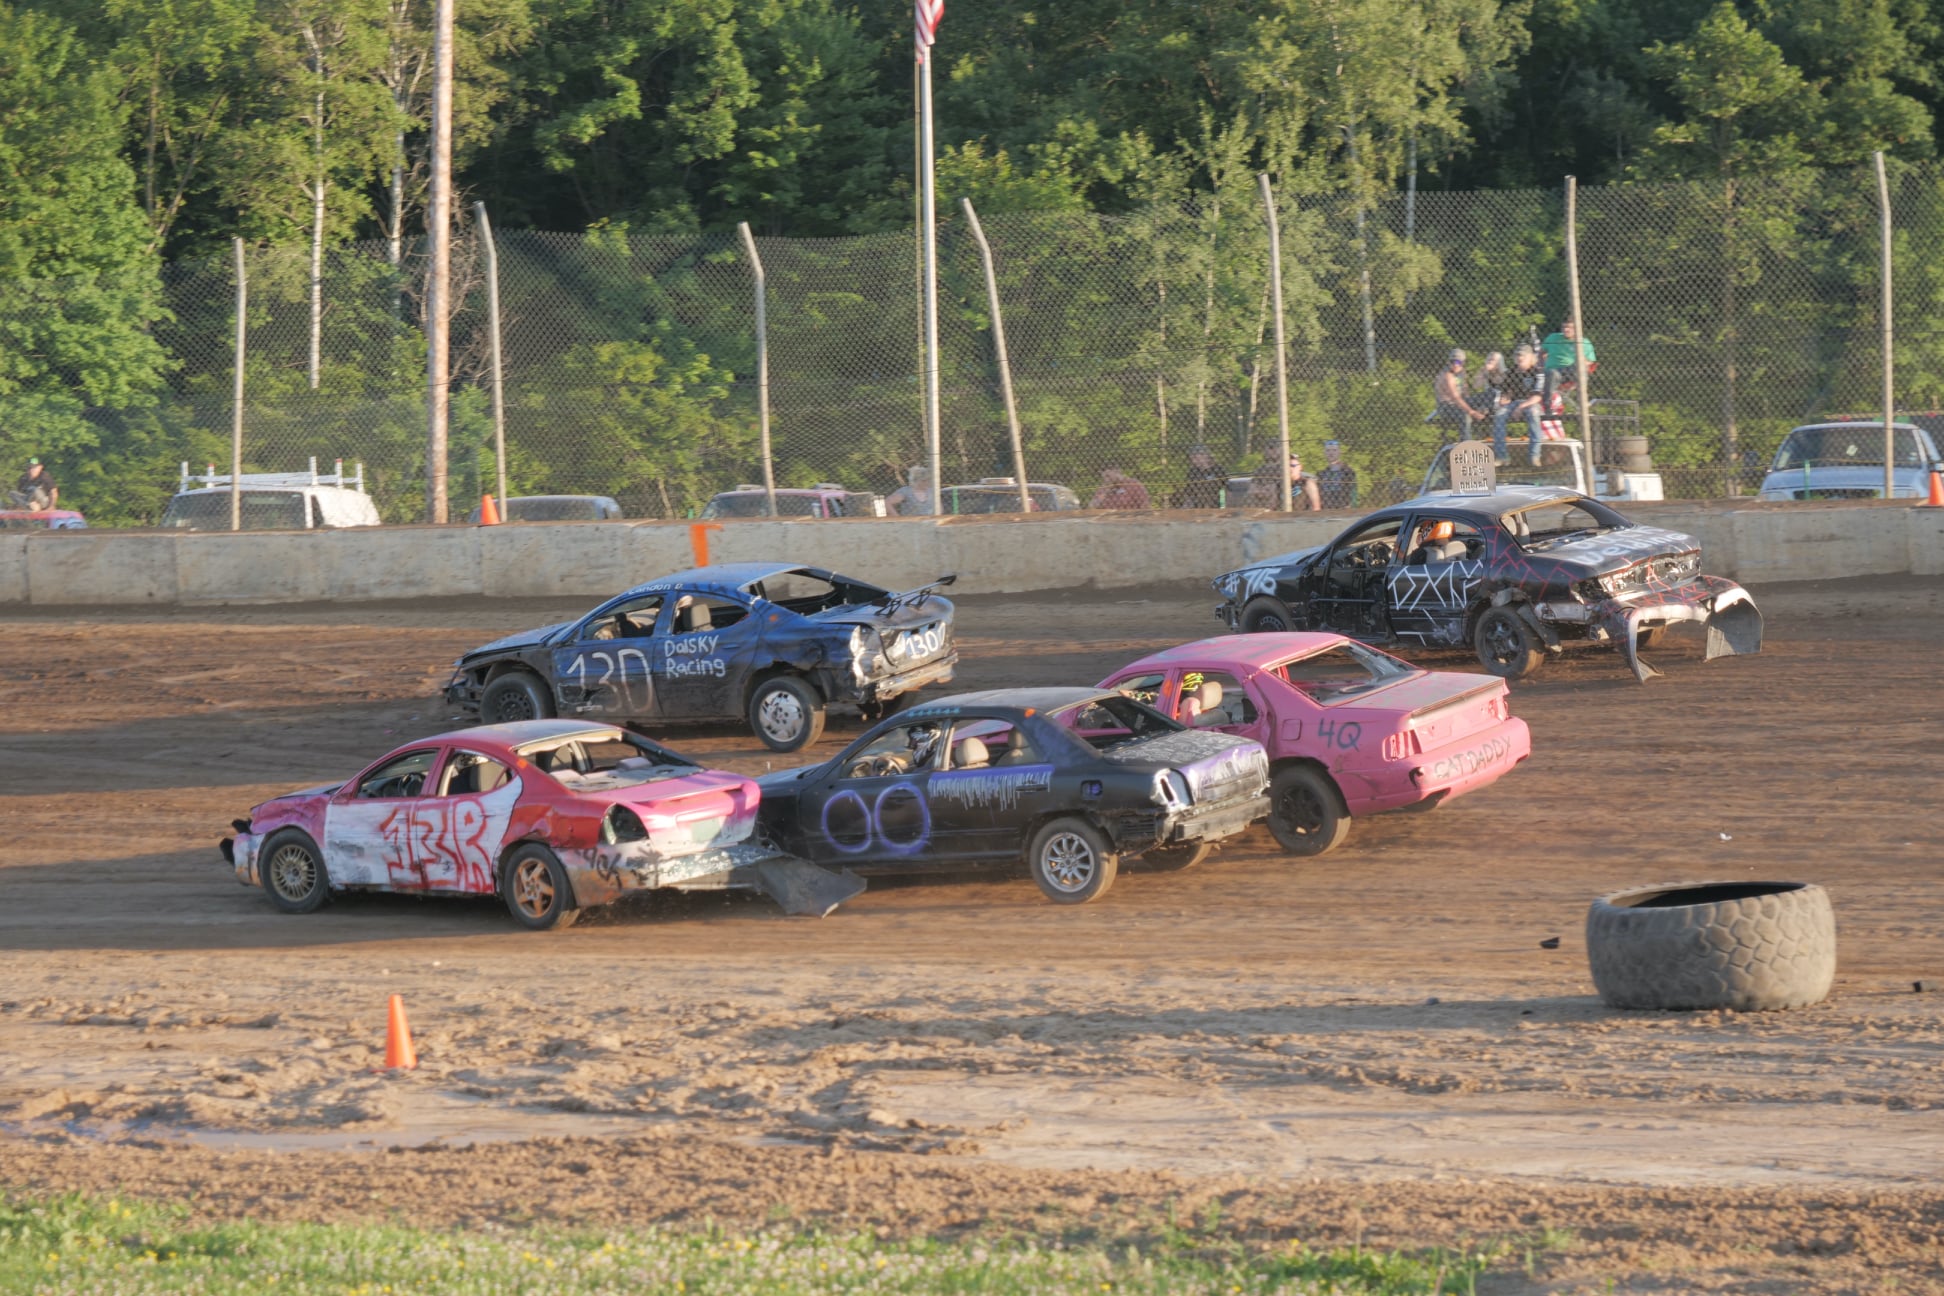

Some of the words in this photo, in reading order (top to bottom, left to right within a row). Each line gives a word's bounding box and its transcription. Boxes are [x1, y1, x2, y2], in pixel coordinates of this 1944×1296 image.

[566, 648, 654, 713] 130
[666, 658, 726, 679] Racing
[1318, 718, 1362, 752] 4Q
